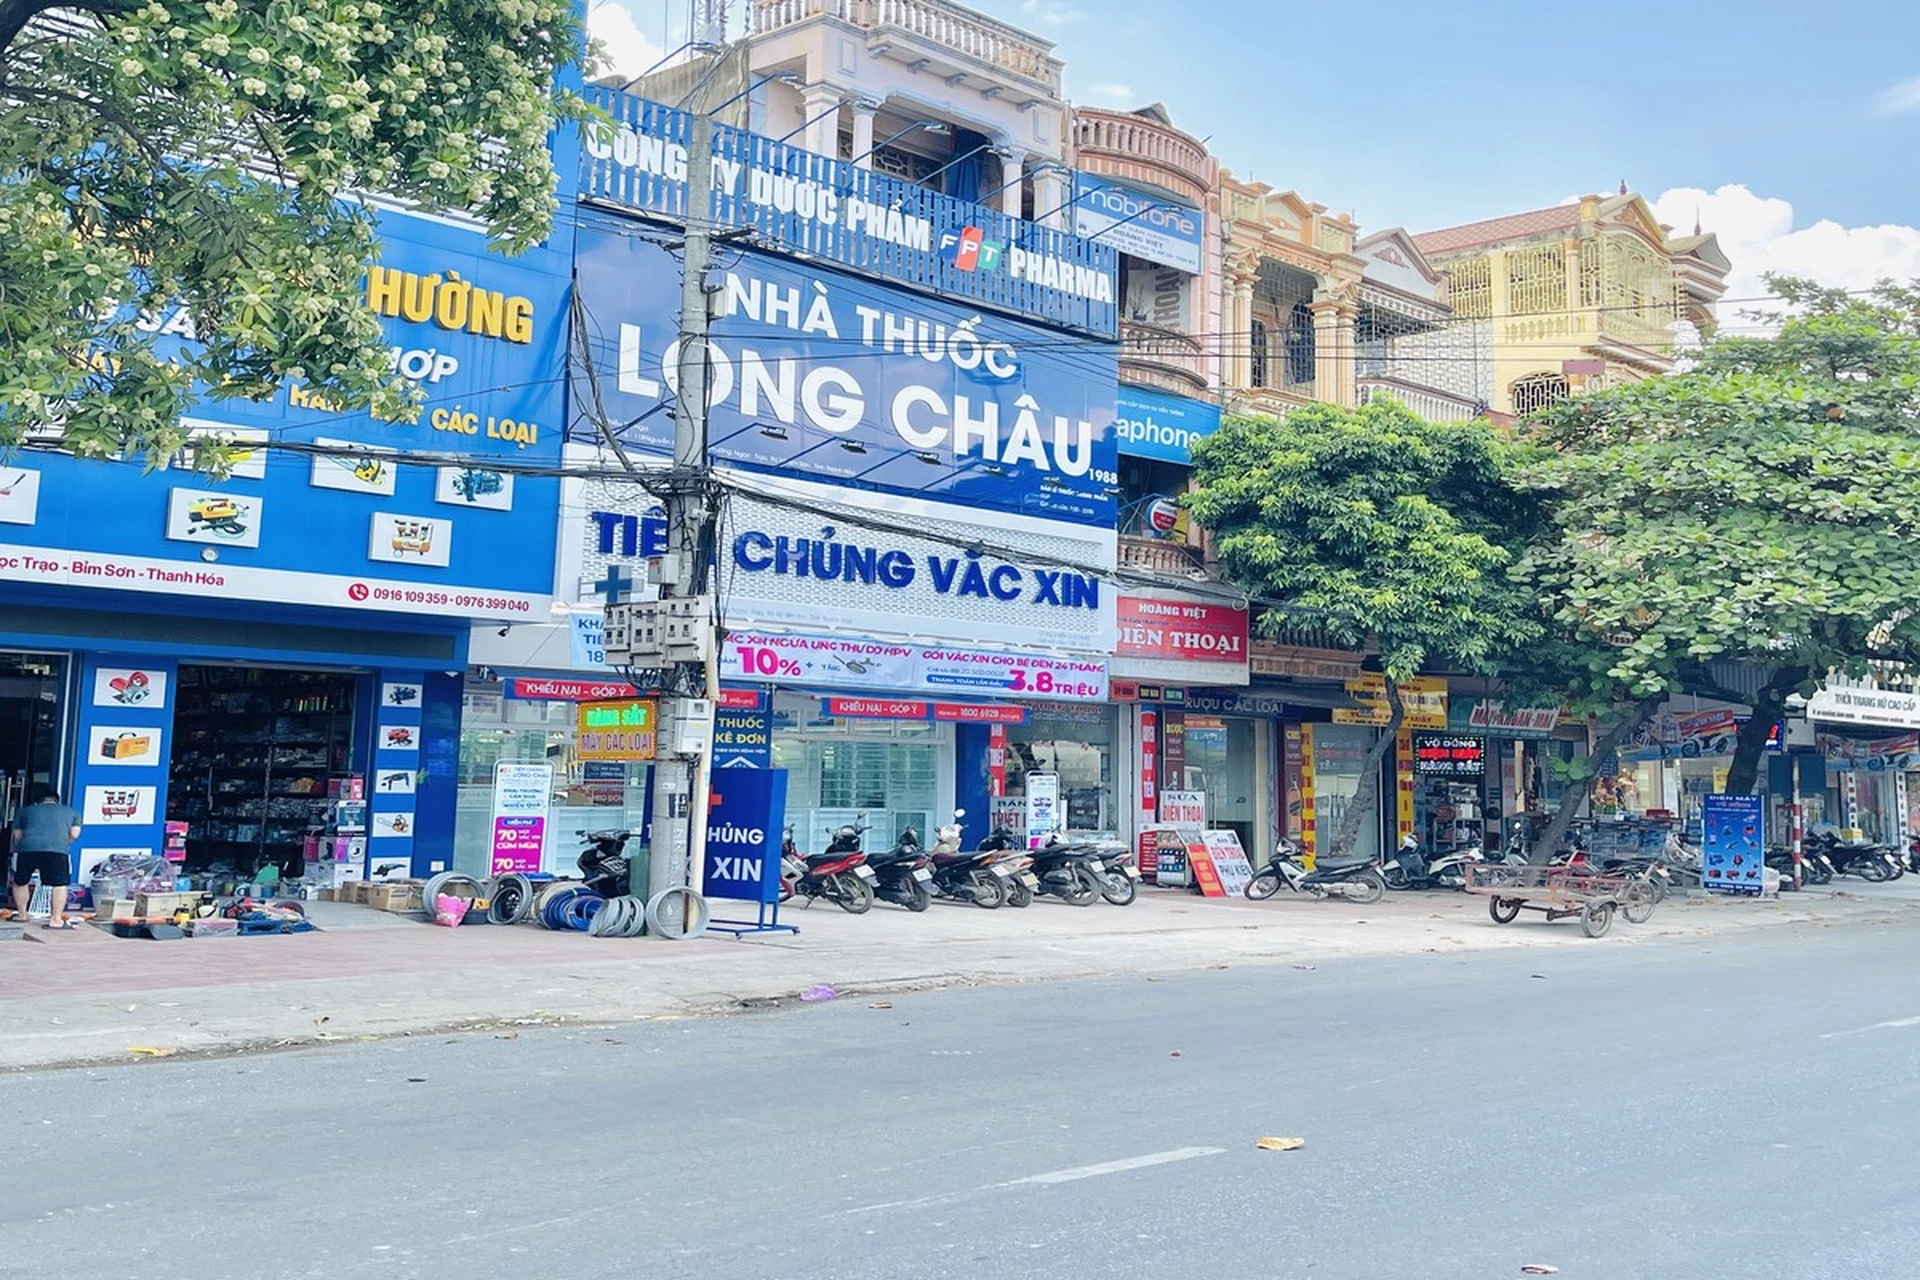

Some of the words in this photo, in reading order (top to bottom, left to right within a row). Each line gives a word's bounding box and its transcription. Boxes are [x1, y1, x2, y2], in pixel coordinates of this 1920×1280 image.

[586, 121, 689, 184] CÔNG
[846, 199, 931, 252] PHẨM
[1010, 243, 1113, 304] PHARMA
[367, 264, 535, 345] HƯỜNG
[726, 272, 839, 339] NHÀ
[856, 304, 1017, 379] THUỐC
[618, 322, 866, 434] LONG
[891, 384, 1092, 477] CHÂU
[431, 405, 479, 435] CÁC
[487, 416, 539, 449] LOẠI
[1117, 417, 1201, 449] aphone
[1089, 467, 1118, 485] 1988
[592, 506, 668, 558] TIÊ
[734, 526, 915, 588] CHỦNG
[1031, 569, 1099, 609] XIN
[22, 557, 58, 573] Trạo
[71, 561, 101, 575] Bỉm
[104, 564, 135, 578] Sơn
[146, 568, 193, 583] Thanh
[195, 574, 225, 586] Hóa
[374, 588, 402, 600] 0916
[405, 591, 423, 602] 109
[425, 593, 448, 605] 359
[455, 595, 484, 608] 0976
[508, 601, 529, 612] 040
[1138, 603, 1180, 616] HOÀNG
[1183, 606, 1208, 620] VIỆT
[578, 619, 604, 630] KH
[1169, 631, 1240, 654] THOẠI
[737, 648, 801, 677] 10%
[971, 655, 990, 664] XIN
[991, 657, 1014, 666] CHO
[1008, 669, 1053, 692] 3.8
[1055, 683, 1099, 698] TRIỆU
[718, 716, 764, 728] THUỐC
[716, 732, 733, 743] KÊ
[736, 733, 766, 744] ĐƠN
[498, 830, 517, 841] 70
[708, 823, 764, 844] HỦNG
[495, 859, 513, 869] 70
[711, 857, 762, 881] XIN
